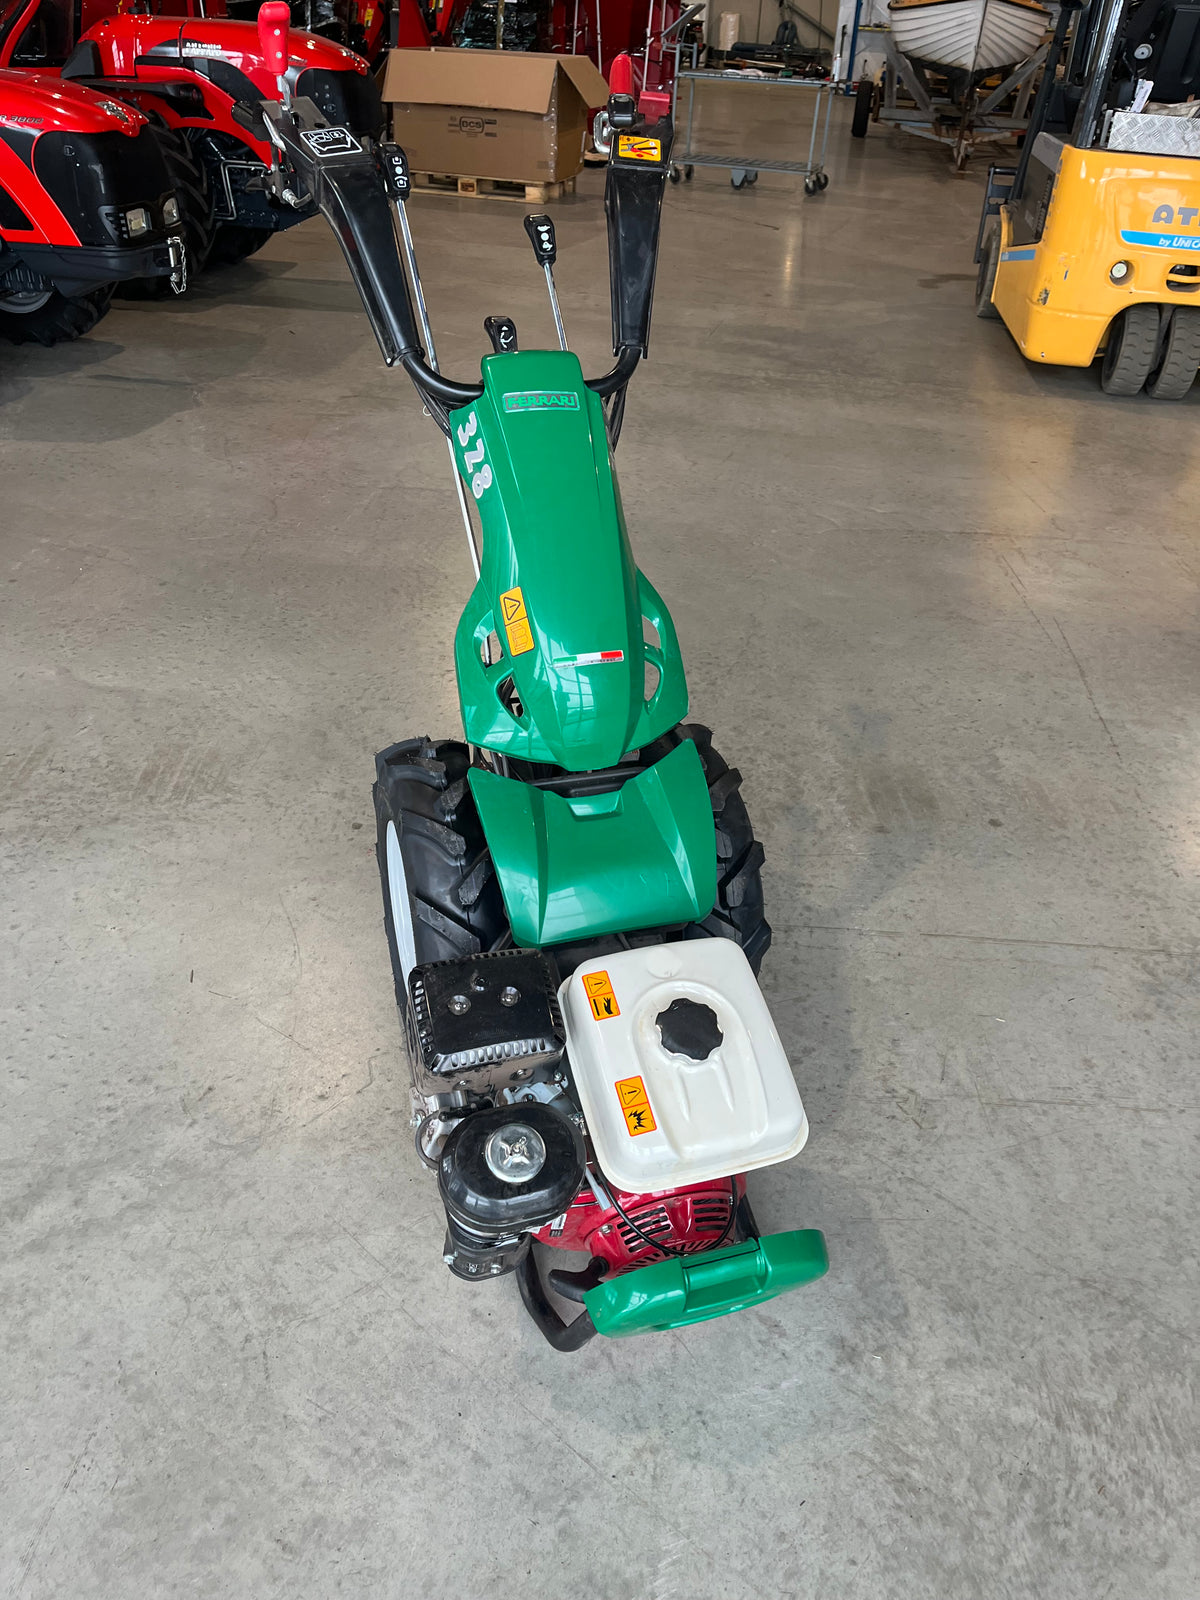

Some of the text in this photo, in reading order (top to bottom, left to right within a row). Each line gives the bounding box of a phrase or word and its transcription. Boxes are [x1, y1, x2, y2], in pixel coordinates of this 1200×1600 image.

[1152, 204, 1200, 226] AT
[1158, 237, 1172, 247] by
[507, 395, 575, 409] FERRARI
[457, 411, 493, 499] 328
